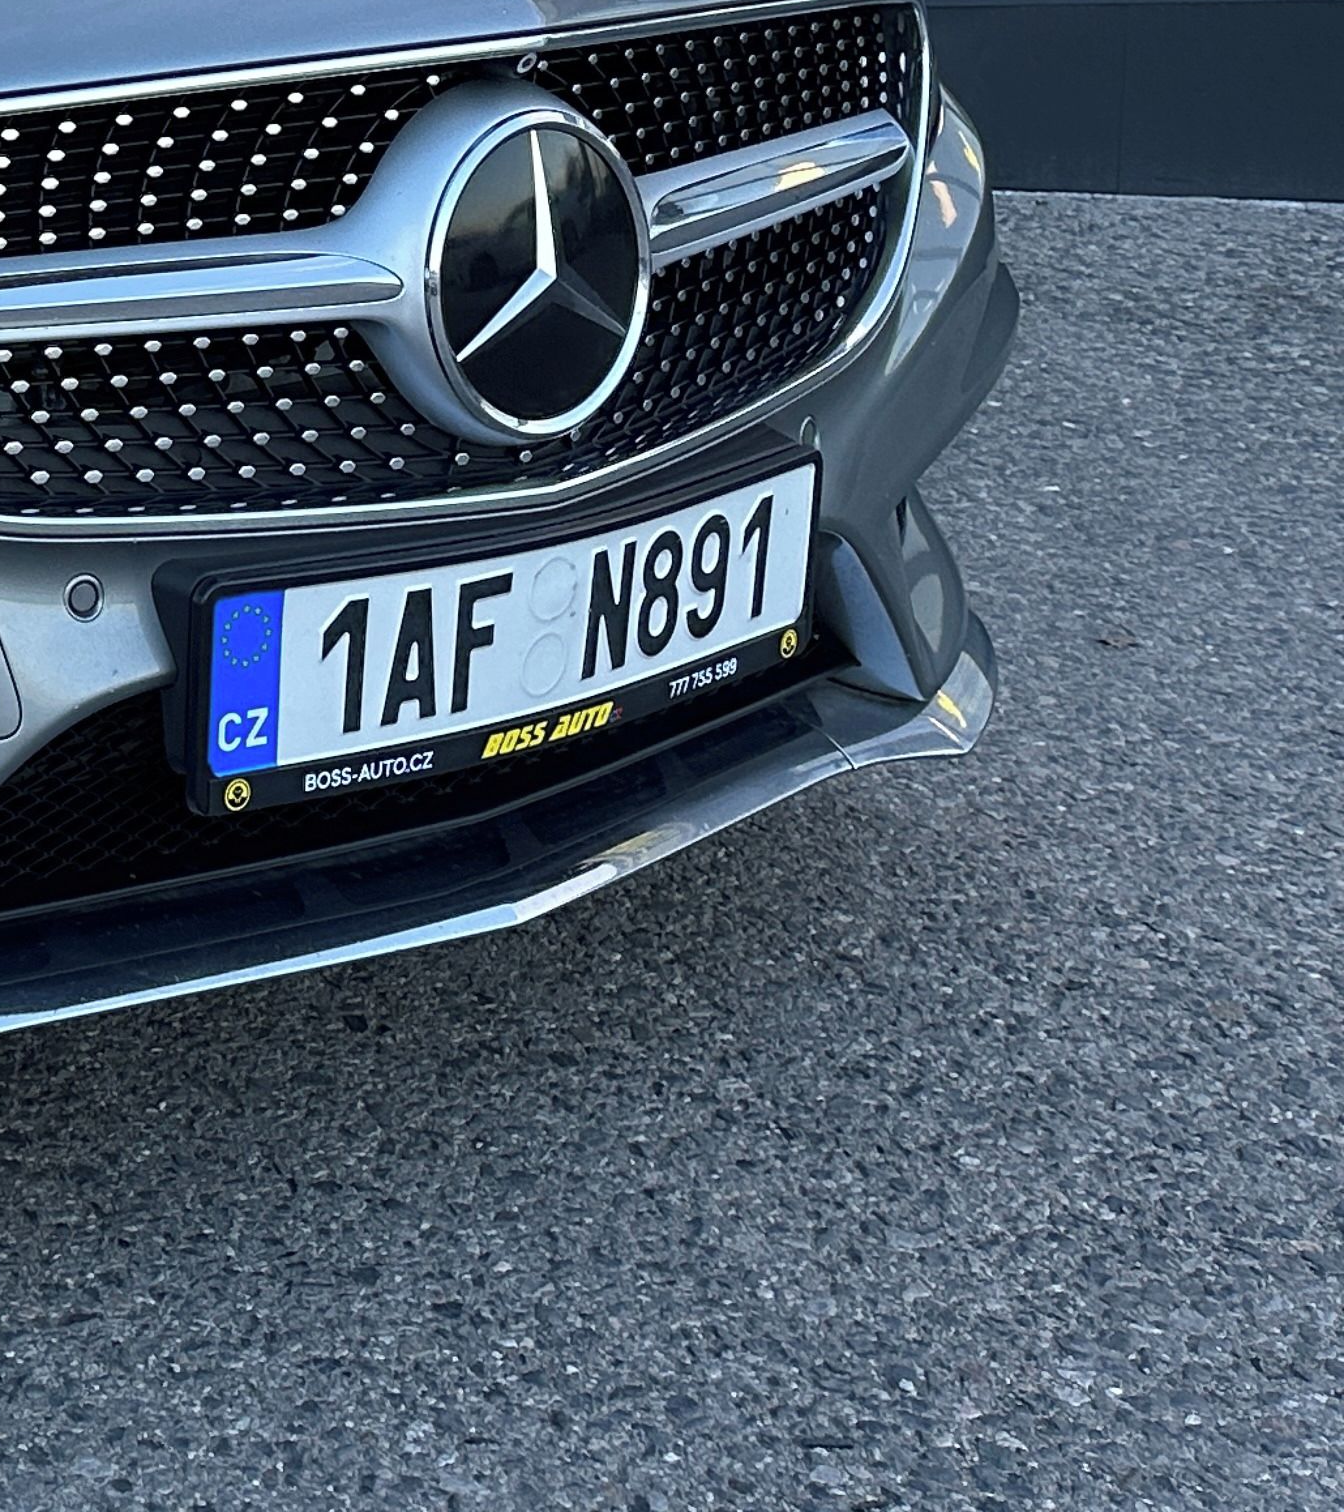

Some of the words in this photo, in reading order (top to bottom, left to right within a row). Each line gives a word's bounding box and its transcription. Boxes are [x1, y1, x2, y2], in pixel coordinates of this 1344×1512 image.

[321, 572, 513, 735] 1AF
[581, 494, 775, 681] N891
[669, 676, 690, 699] 777
[692, 666, 713, 690] 755
[715, 657, 737, 681] 599
[217, 707, 269, 752] CZ
[481, 721, 548, 759] BOSS
[549, 701, 614, 743] AUTO
[304, 751, 434, 792] BOSS-AUTO.CZ
